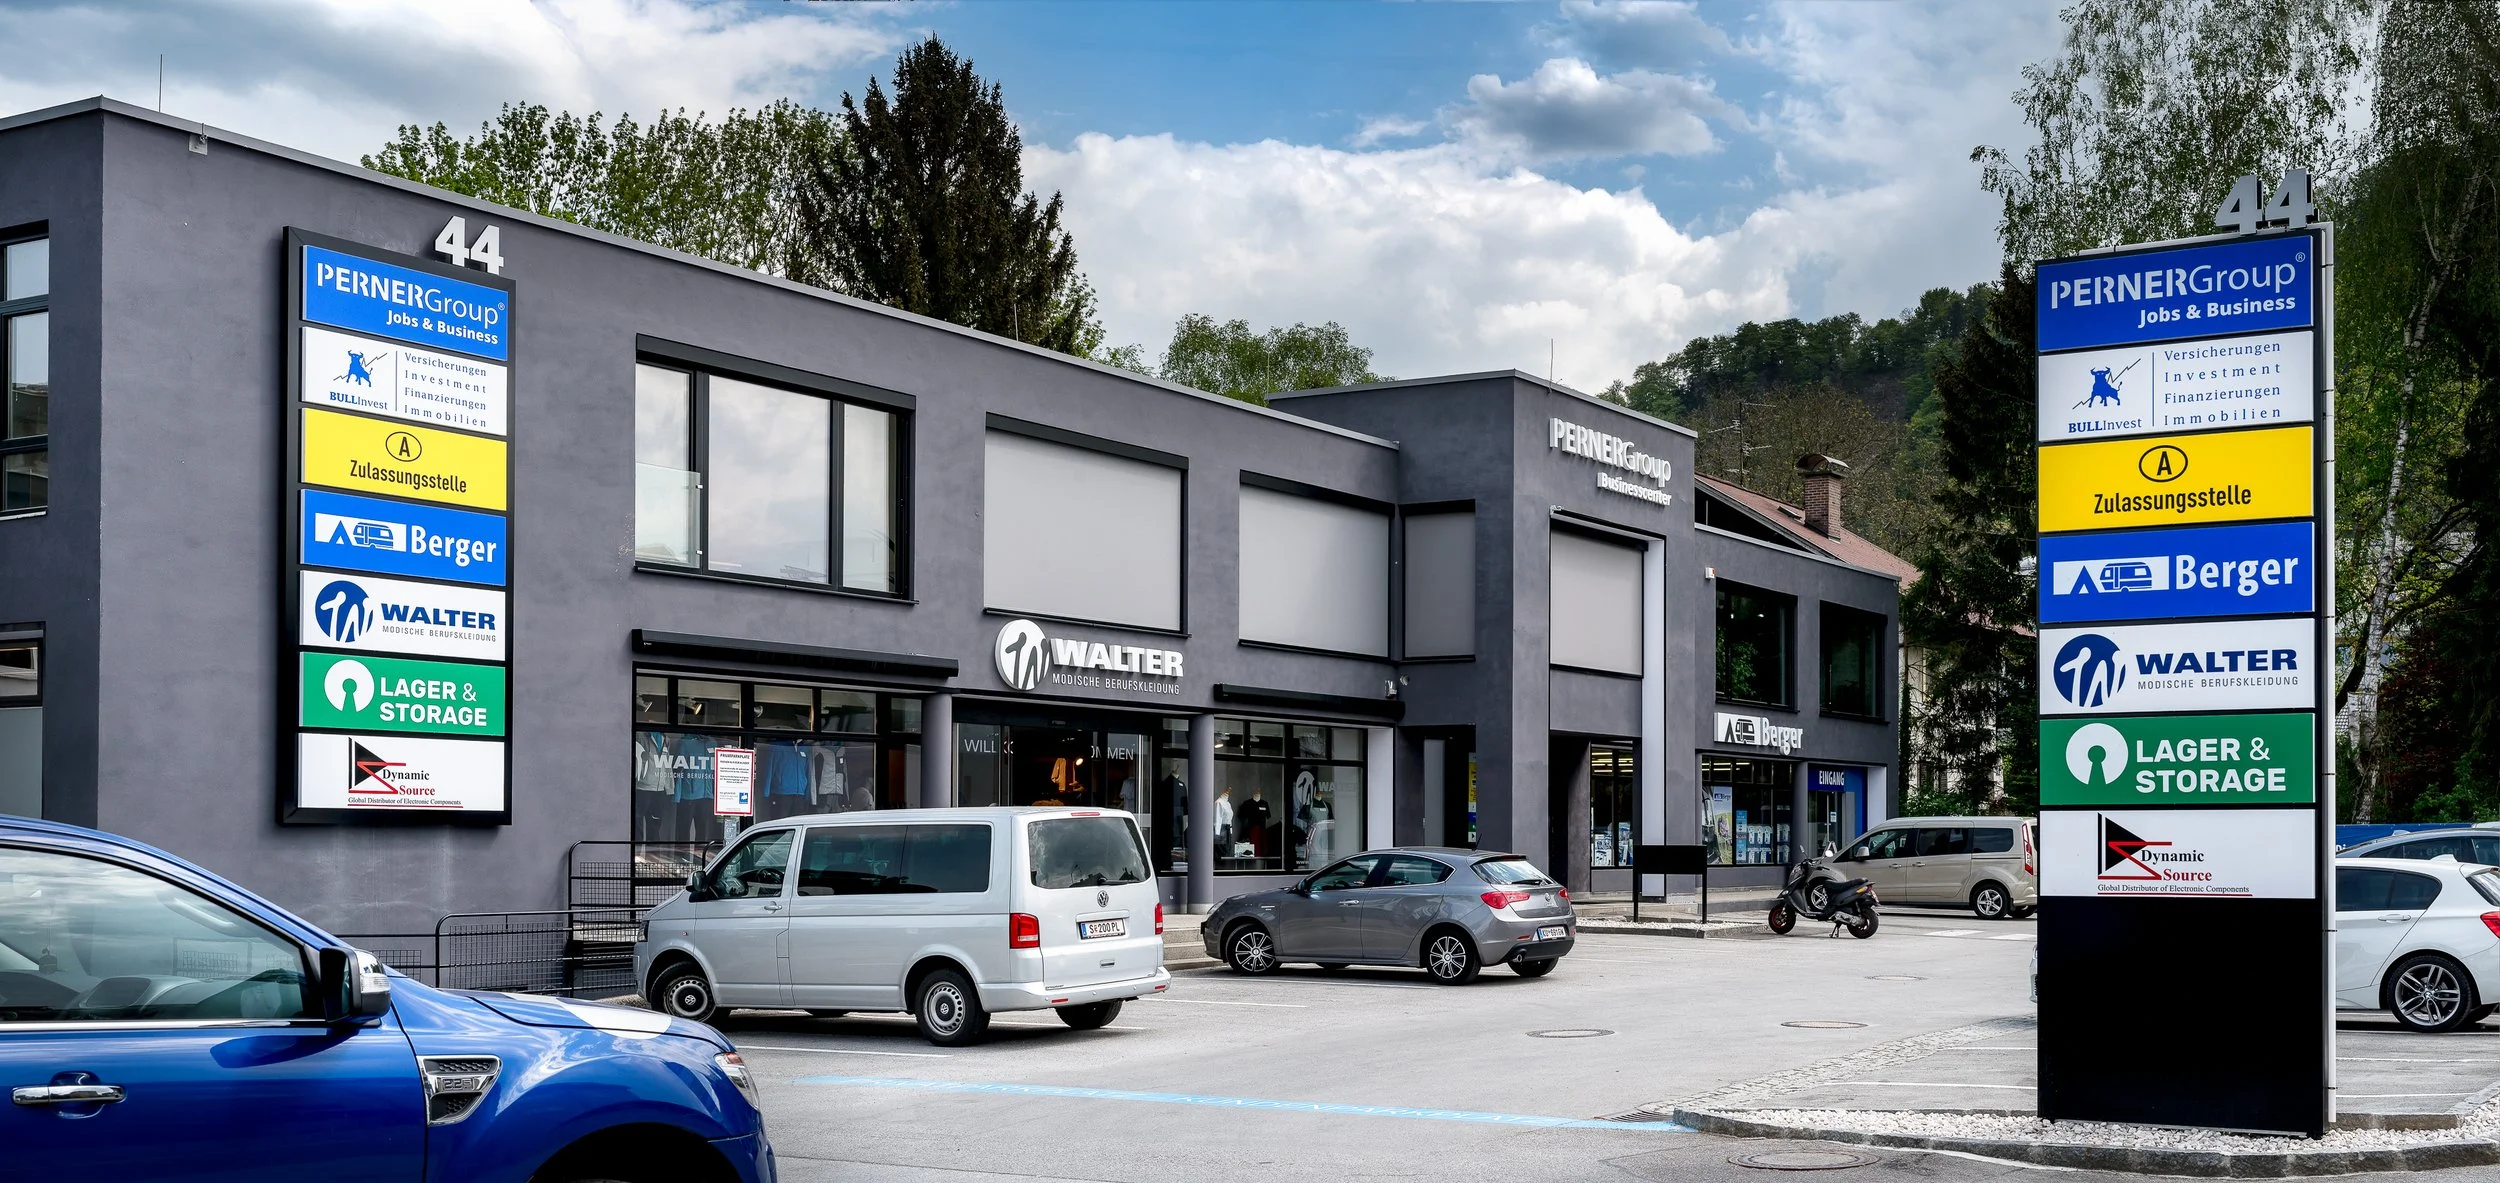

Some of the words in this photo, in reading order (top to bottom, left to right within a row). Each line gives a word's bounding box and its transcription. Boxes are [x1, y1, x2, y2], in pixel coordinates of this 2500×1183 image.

[2215, 168, 2315, 236] 44
[434, 215, 504, 275] 44
[2138, 308, 2181, 328] Jobs
[2186, 304, 2201, 320] &
[2207, 295, 2296, 318] Business
[386, 309, 419, 328] Jobs
[422, 317, 434, 331] &
[437, 321, 498, 345] Business
[2164, 341, 2281, 361] Versicherungen
[405, 352, 487, 377] Versicherungen
[2164, 363, 2281, 383] Investment
[405, 370, 487, 394] Investment
[329, 391, 388, 410] BULLInvest
[405, 387, 487, 411] Finanzierungen
[2164, 385, 2281, 404] Finanzierungen
[405, 405, 487, 428] Immobilien
[2068, 417, 2142, 434] BULLInvest
[2164, 407, 2281, 426] Immobilien
[398, 436, 411, 458] A
[1549, 417, 1672, 488] PERNERGroup
[2156, 451, 2172, 476] A
[350, 459, 467, 493] Zulassungsstelle
[1597, 472, 1673, 506] Businesscenter
[2093, 484, 2252, 514] Zulassungsstelle
[410, 525, 497, 567] Berger
[2176, 554, 2298, 597] Berger
[381, 603, 496, 630] WALTER
[382, 626, 425, 636] MODISCHE
[429, 629, 497, 642] BERUFSKLEIDUNG
[1050, 637, 1185, 678] WALTER
[2136, 648, 2297, 675] WALTER
[380, 676, 456, 701] LAGER
[462, 683, 477, 702] &
[1052, 672, 1100, 689] MODISCHE
[1105, 677, 1180, 695] BERUFSKLEIDUNG
[2138, 678, 2194, 690] MODISCHE
[2201, 676, 2298, 688] BERUFSKLEIDUNG
[379, 702, 487, 727] STORAGE
[1760, 717, 1804, 755] Berger
[2136, 738, 2240, 763] LAGER
[2249, 737, 2271, 760] &
[382, 768, 430, 782] Dynamic
[1818, 770, 1845, 786] EINGANG
[2136, 767, 2286, 793] STORAGE
[367, 797, 396, 805] Distributor
[430, 799, 461, 807] Components
[399, 785, 436, 796] Source
[2141, 849, 2205, 867] Dynamic
[2163, 869, 2212, 882] Source
[2097, 883, 2120, 893] Global
[2121, 883, 2158, 893] Distributor
[2160, 883, 2168, 893] of
[2169, 883, 2204, 893] Electronic
[2206, 884, 2250, 895] Components
